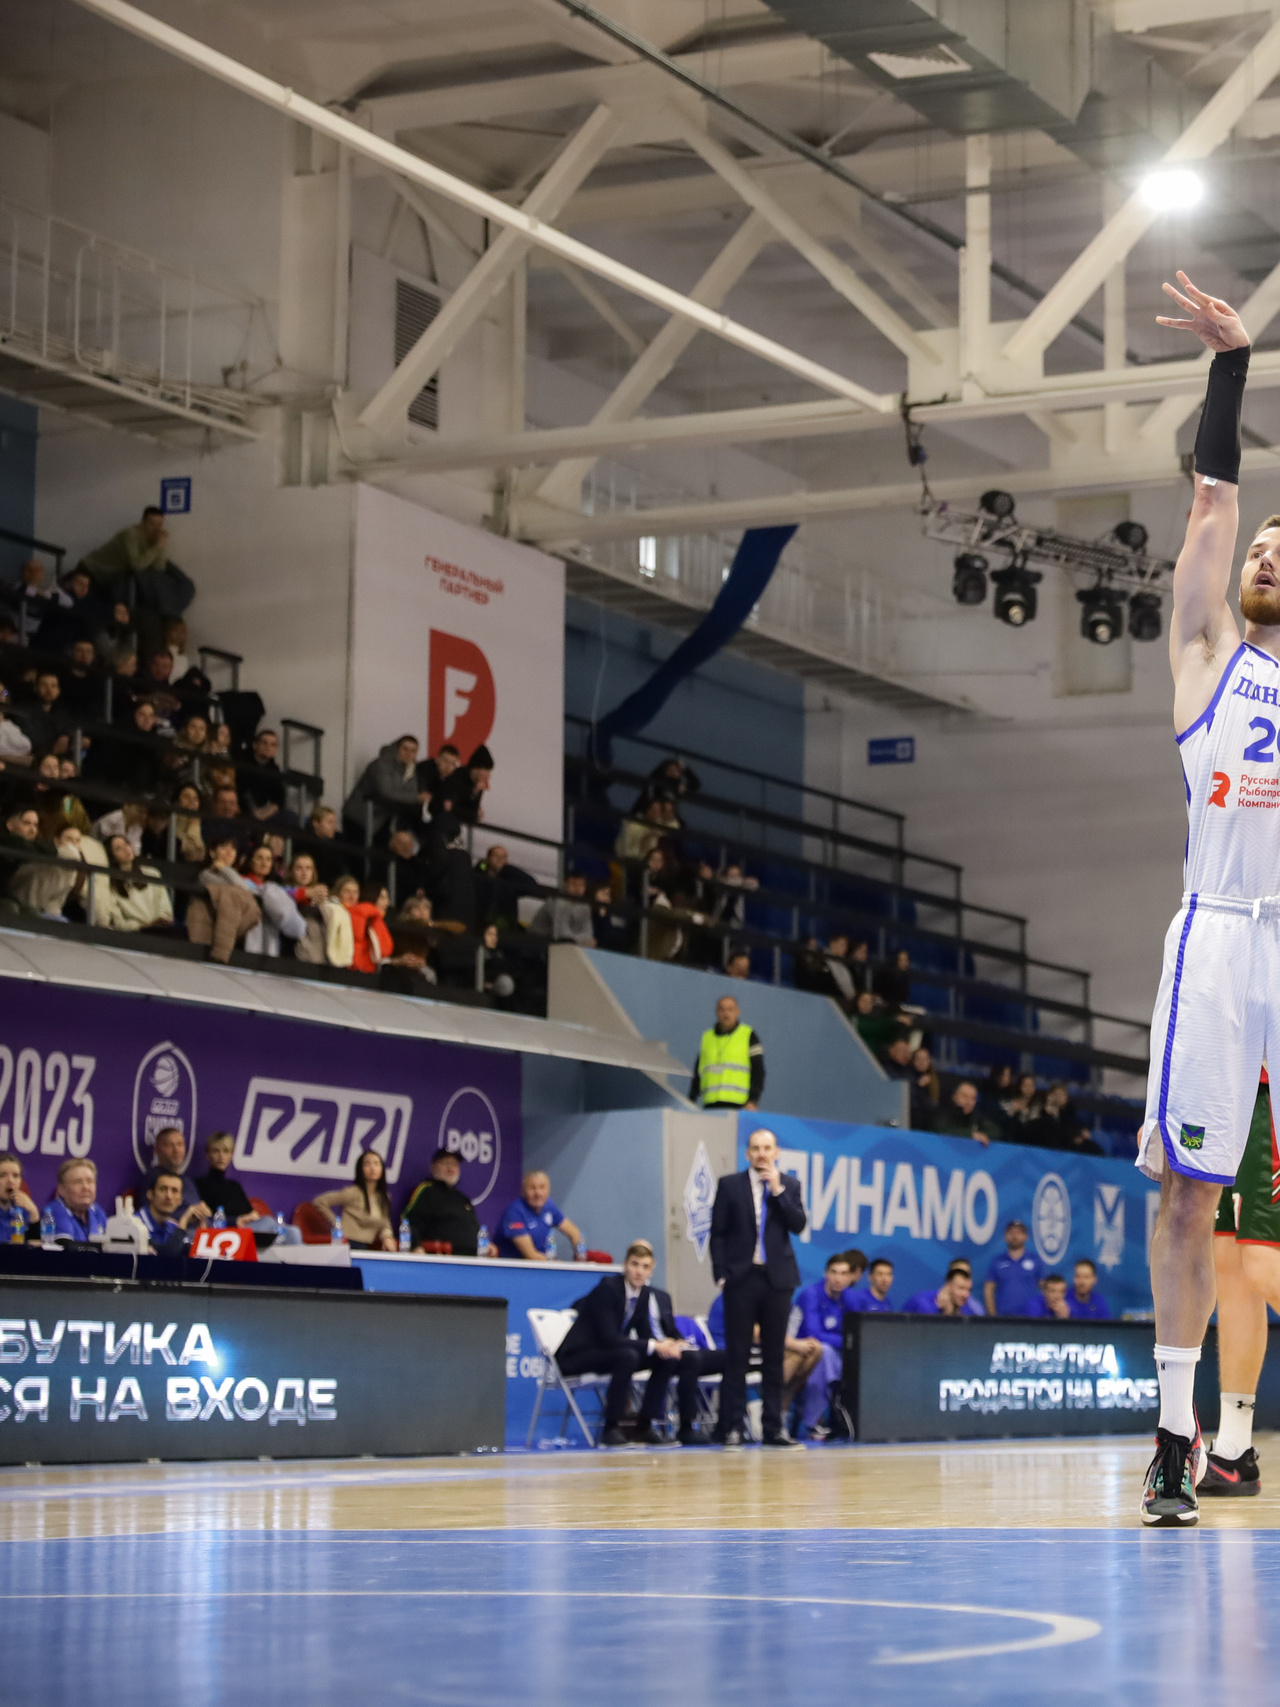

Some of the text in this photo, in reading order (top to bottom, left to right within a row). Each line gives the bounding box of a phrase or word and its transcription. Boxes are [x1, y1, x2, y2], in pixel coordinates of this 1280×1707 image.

[448, 1129, 493, 1165] РФБ
[778, 1148, 998, 1247] ДИНАМО
[69, 1376, 149, 1422] НА
[165, 1376, 338, 1426] ВХОДЕ
